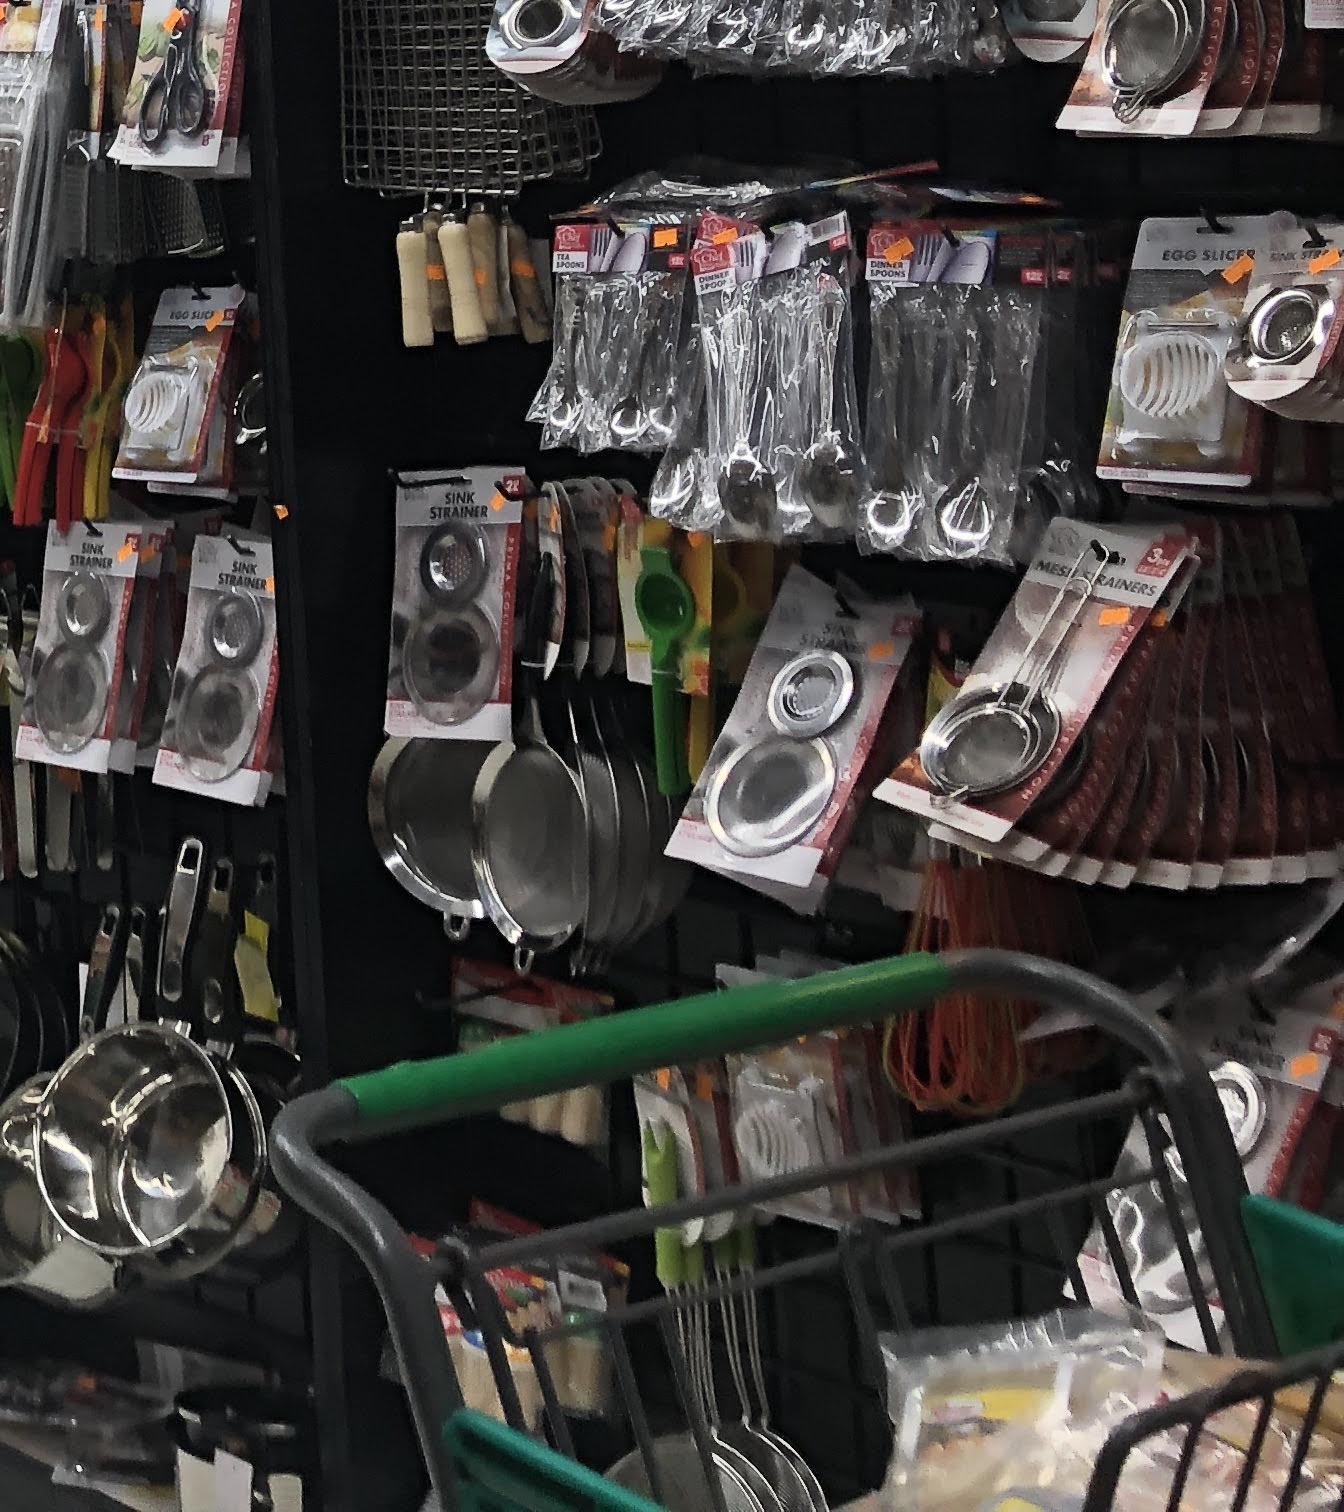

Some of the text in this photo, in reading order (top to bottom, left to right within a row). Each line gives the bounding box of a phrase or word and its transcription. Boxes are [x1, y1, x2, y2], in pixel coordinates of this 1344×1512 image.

[218, 17, 236, 103] COLLECTION
[1162, 248, 1257, 262] EGG SLICER
[870, 269, 906, 278] SPOONS
[445, 491, 476, 505] SINK
[429, 505, 489, 520] STRAINER
[81, 542, 105, 556] SINK
[69, 554, 113, 570] STRAINER
[232, 561, 257, 575] SINK
[218, 573, 267, 590] STRAINER
